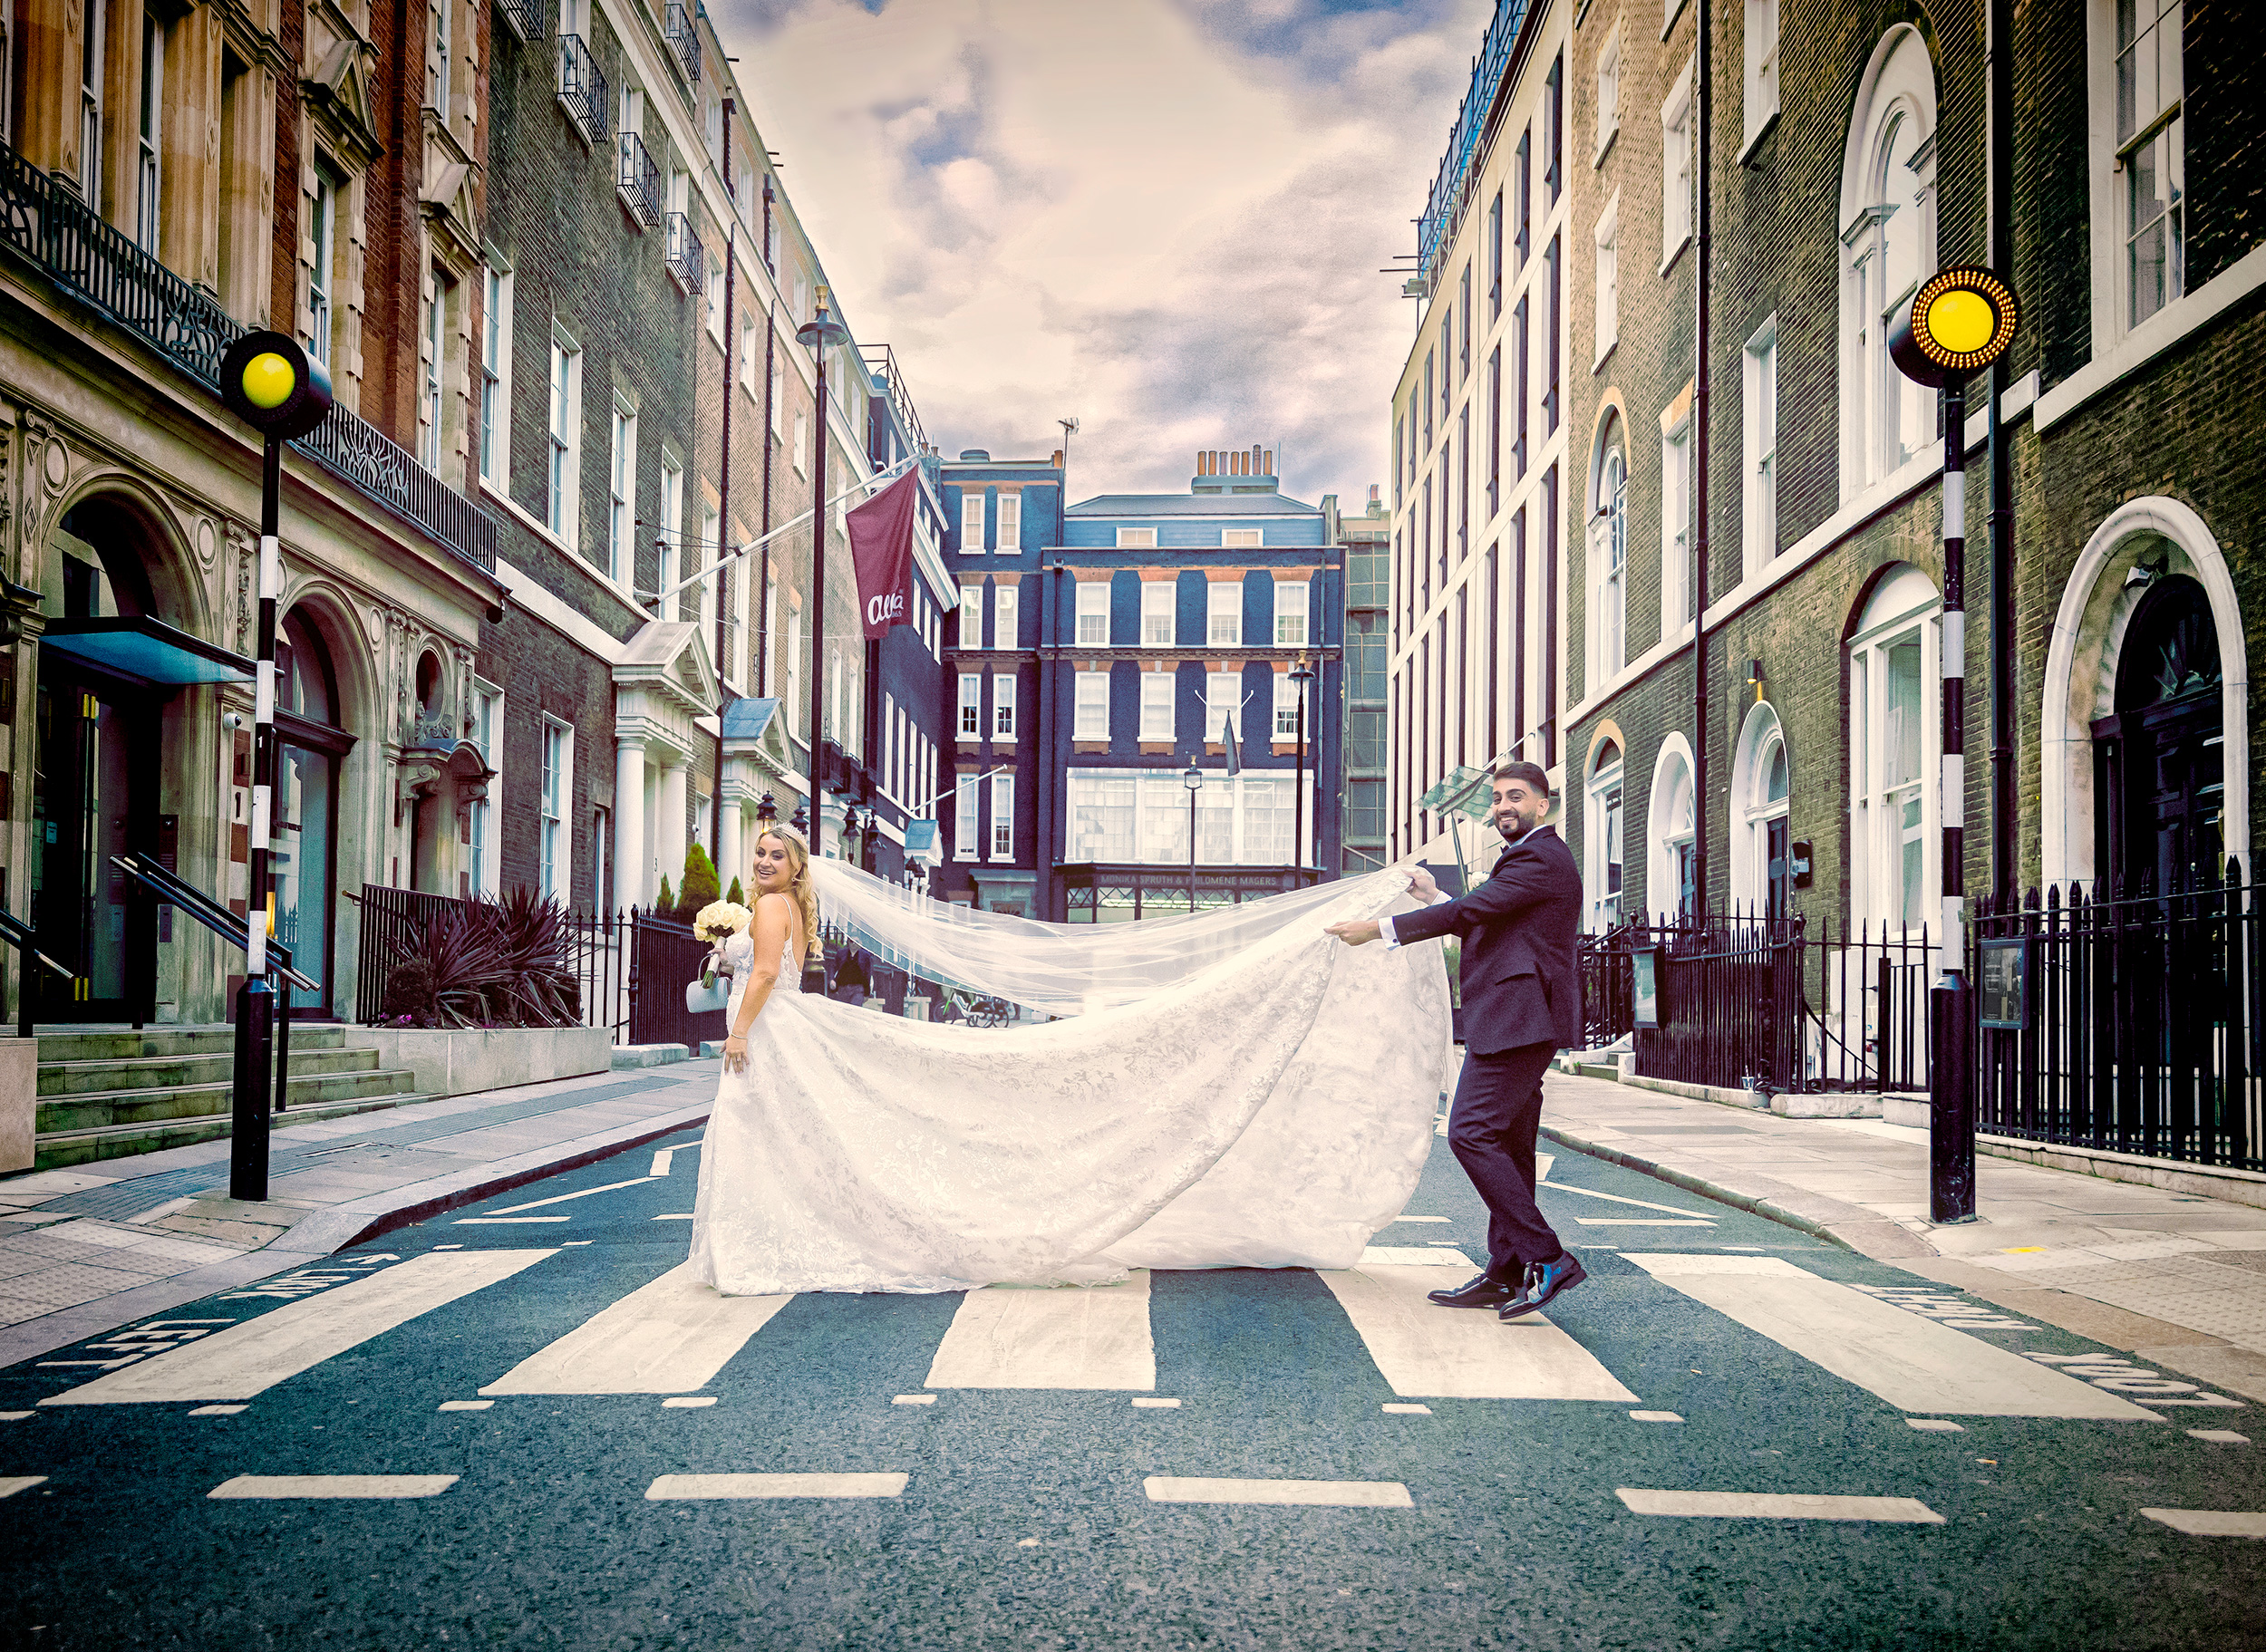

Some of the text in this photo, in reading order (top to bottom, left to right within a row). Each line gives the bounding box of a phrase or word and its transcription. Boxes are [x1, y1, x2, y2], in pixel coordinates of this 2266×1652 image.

[257, 735, 263, 749] 1
[1100, 875, 1137, 884] MONIKA
[1176, 876, 1182, 884] &
[1239, 876, 1276, 885] MAGERS
[35, 1267, 377, 1369] LOOK LEFT
[2020, 1351, 2246, 1407] LOOK
